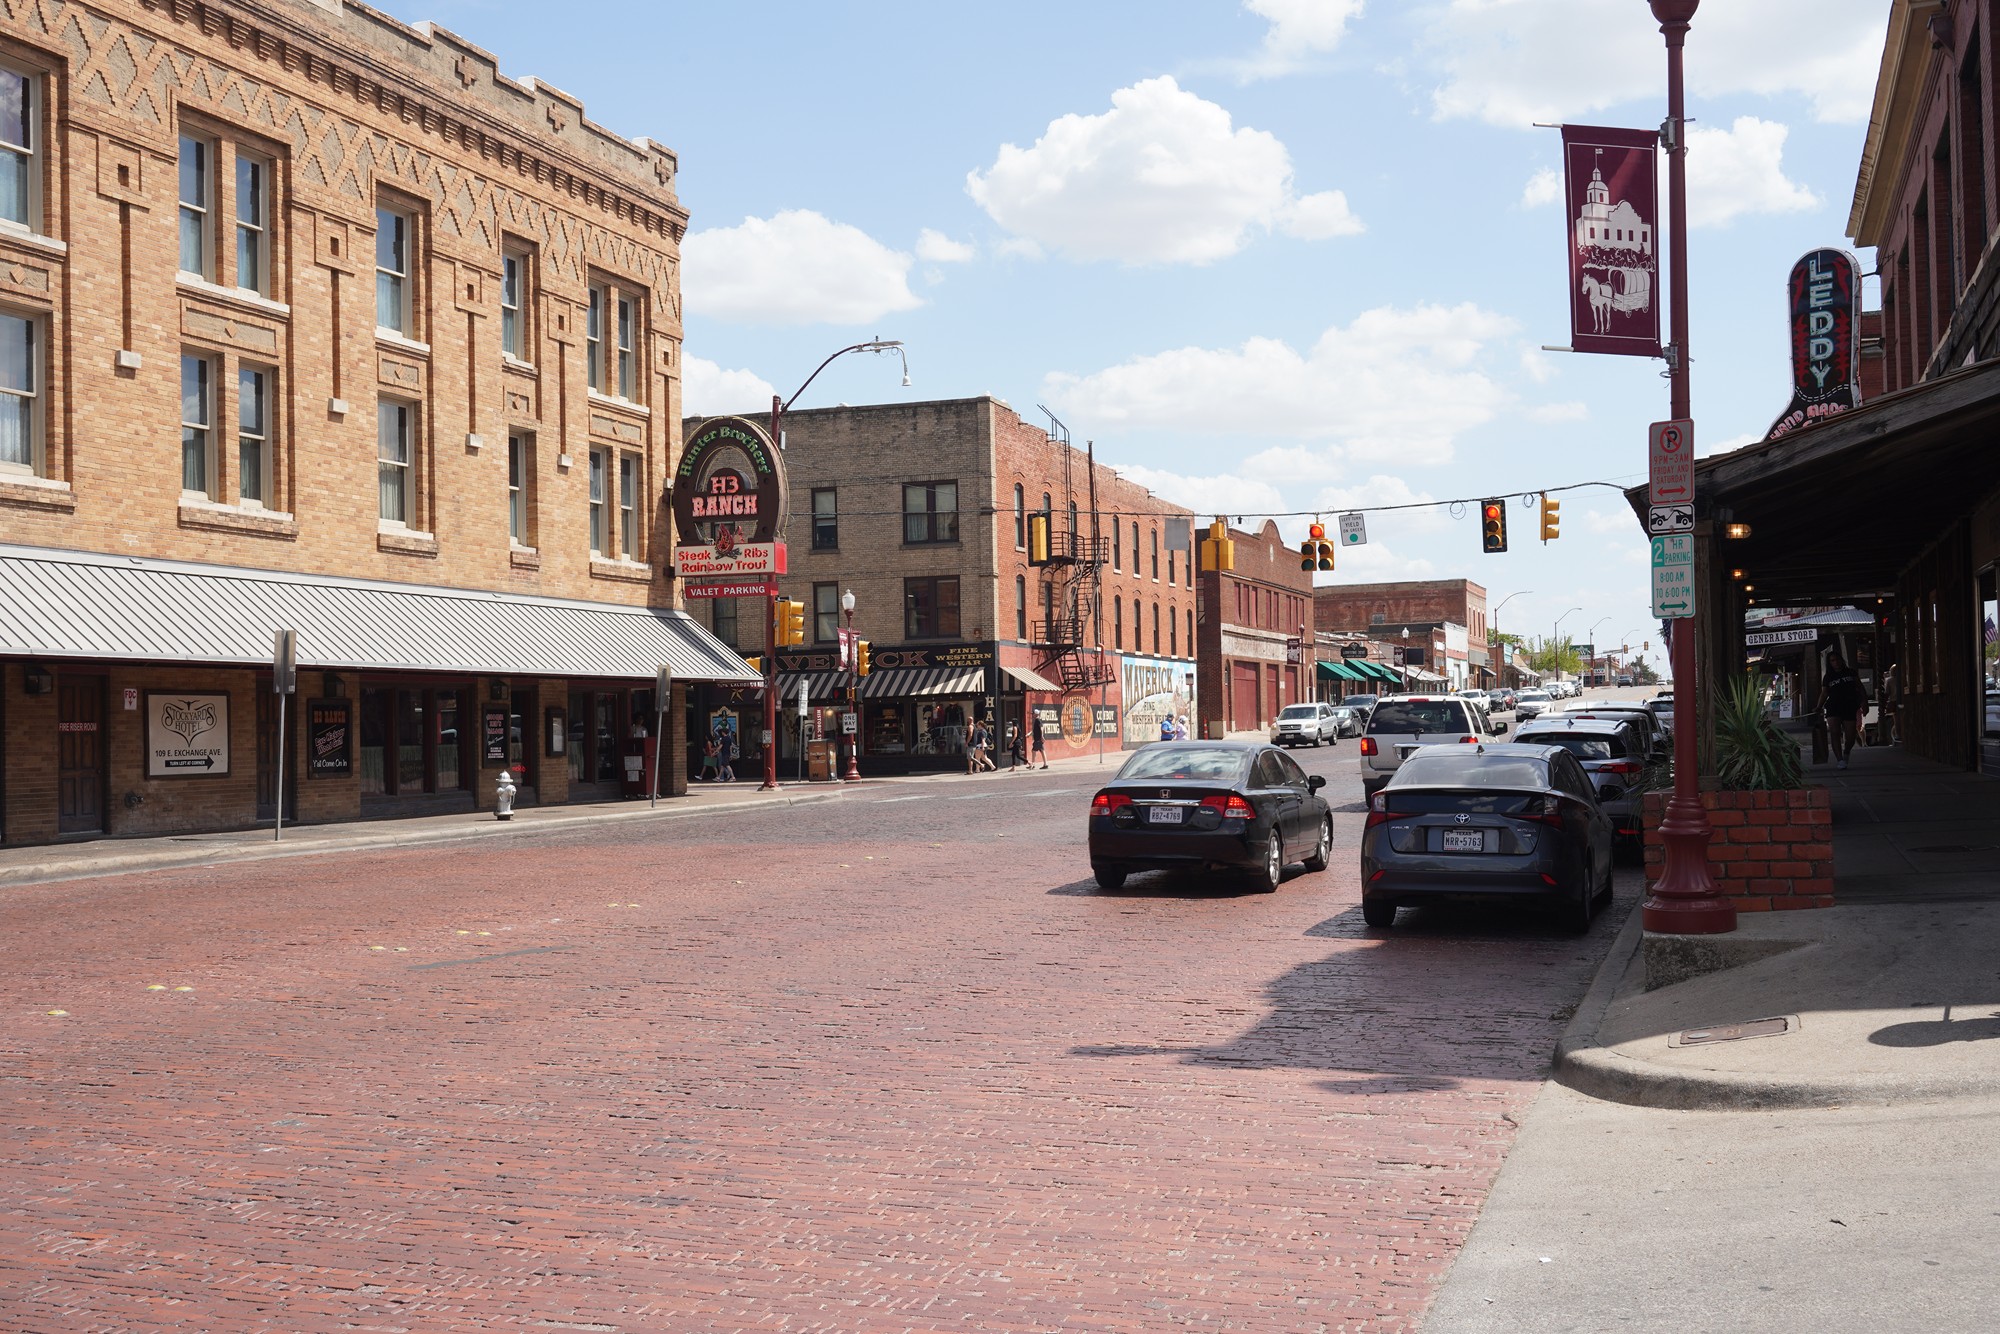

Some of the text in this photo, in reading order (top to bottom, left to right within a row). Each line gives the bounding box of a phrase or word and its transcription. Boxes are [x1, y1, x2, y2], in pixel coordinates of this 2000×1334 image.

[1809, 258, 1834, 388] LEDDY
[680, 430, 718, 477] Hunter
[1653, 464, 1689, 475] FRIDAY AND
[710, 476, 739, 494] H3
[1656, 474, 1686, 484] SATURDAY
[691, 494, 758, 517] RANCH
[678, 548, 769, 561] Steak Ribs
[1653, 539, 1683, 563] 2 HR
[1665, 551, 1691, 563] PARKING
[681, 560, 768, 573] Rainbow Trout
[1660, 571, 1684, 583] 8:00 AM
[690, 585, 766, 596] VALET PARKING
[1656, 586, 1690, 598] TO 6:00 PM
[1748, 630, 1814, 644] GENERAL STORE
[935, 653, 992, 661] WESTERN
[124, 690, 137, 699] FDC
[1124, 664, 1173, 716] MAVERICK
[1144, 702, 1155, 710] FINE
[164, 706, 215, 727] STOCKYARDS
[1132, 714, 1166, 725] WESTERN WEA
[60, 722, 97, 731] FIRE RISER ROOM
[174, 720, 202, 736] HOTEL
[322, 759, 334, 768] Come
[335, 758, 342, 767] On
